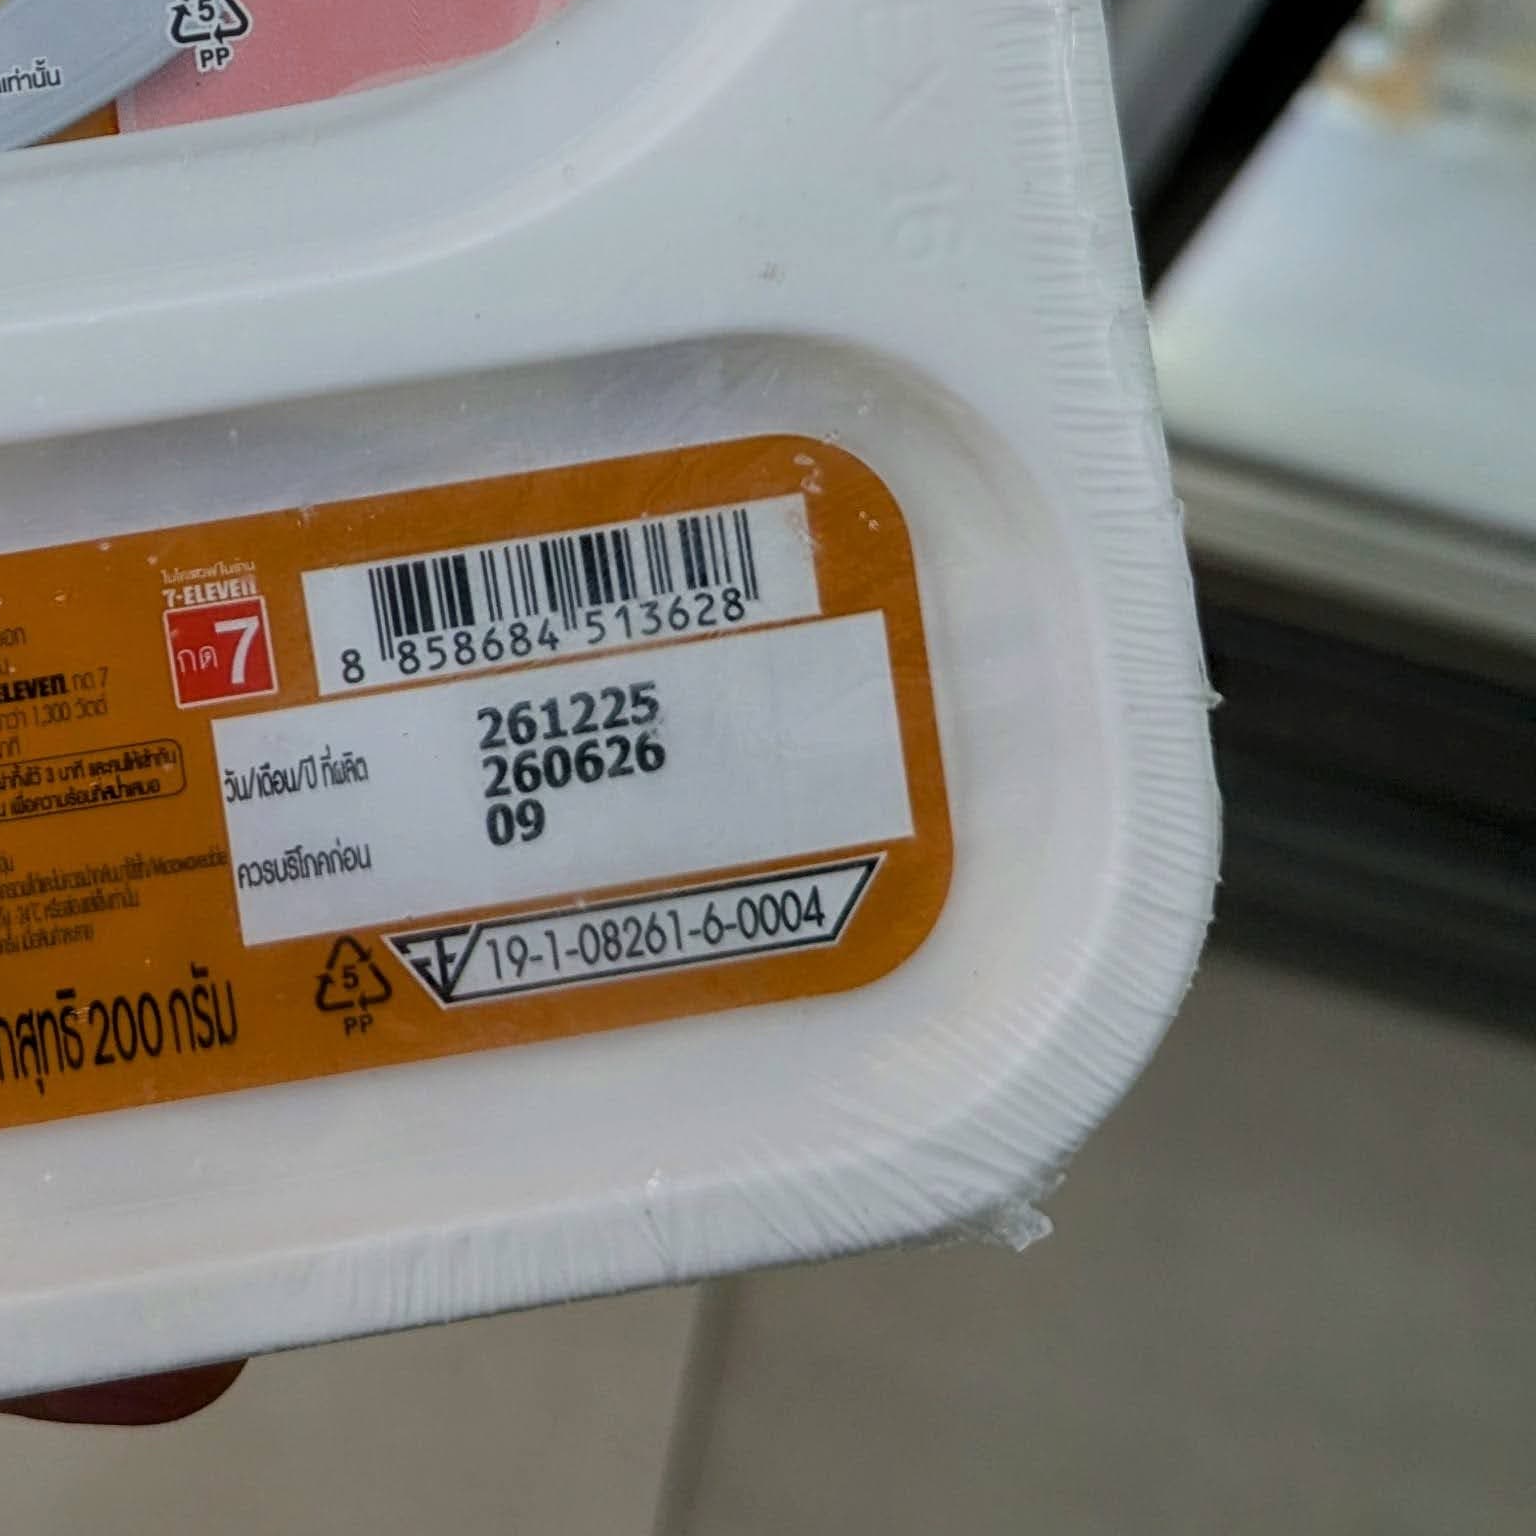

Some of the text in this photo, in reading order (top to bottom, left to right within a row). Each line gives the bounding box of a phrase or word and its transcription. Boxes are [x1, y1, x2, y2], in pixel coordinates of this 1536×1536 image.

[200, 47, 230, 68] PP
[215, 616, 259, 684] 7
[341, 585, 747, 684] 8 858684 513628
[479, 681, 658, 749] 261225
[483, 731, 666, 797] 260626
[486, 799, 545, 846] 09
[487, 887, 826, 978] 19-1-08261-6-0004
[90, 993, 163, 1065] 200
[170, 962, 239, 1053] กรัม
[341, 1010, 378, 1037] PP
